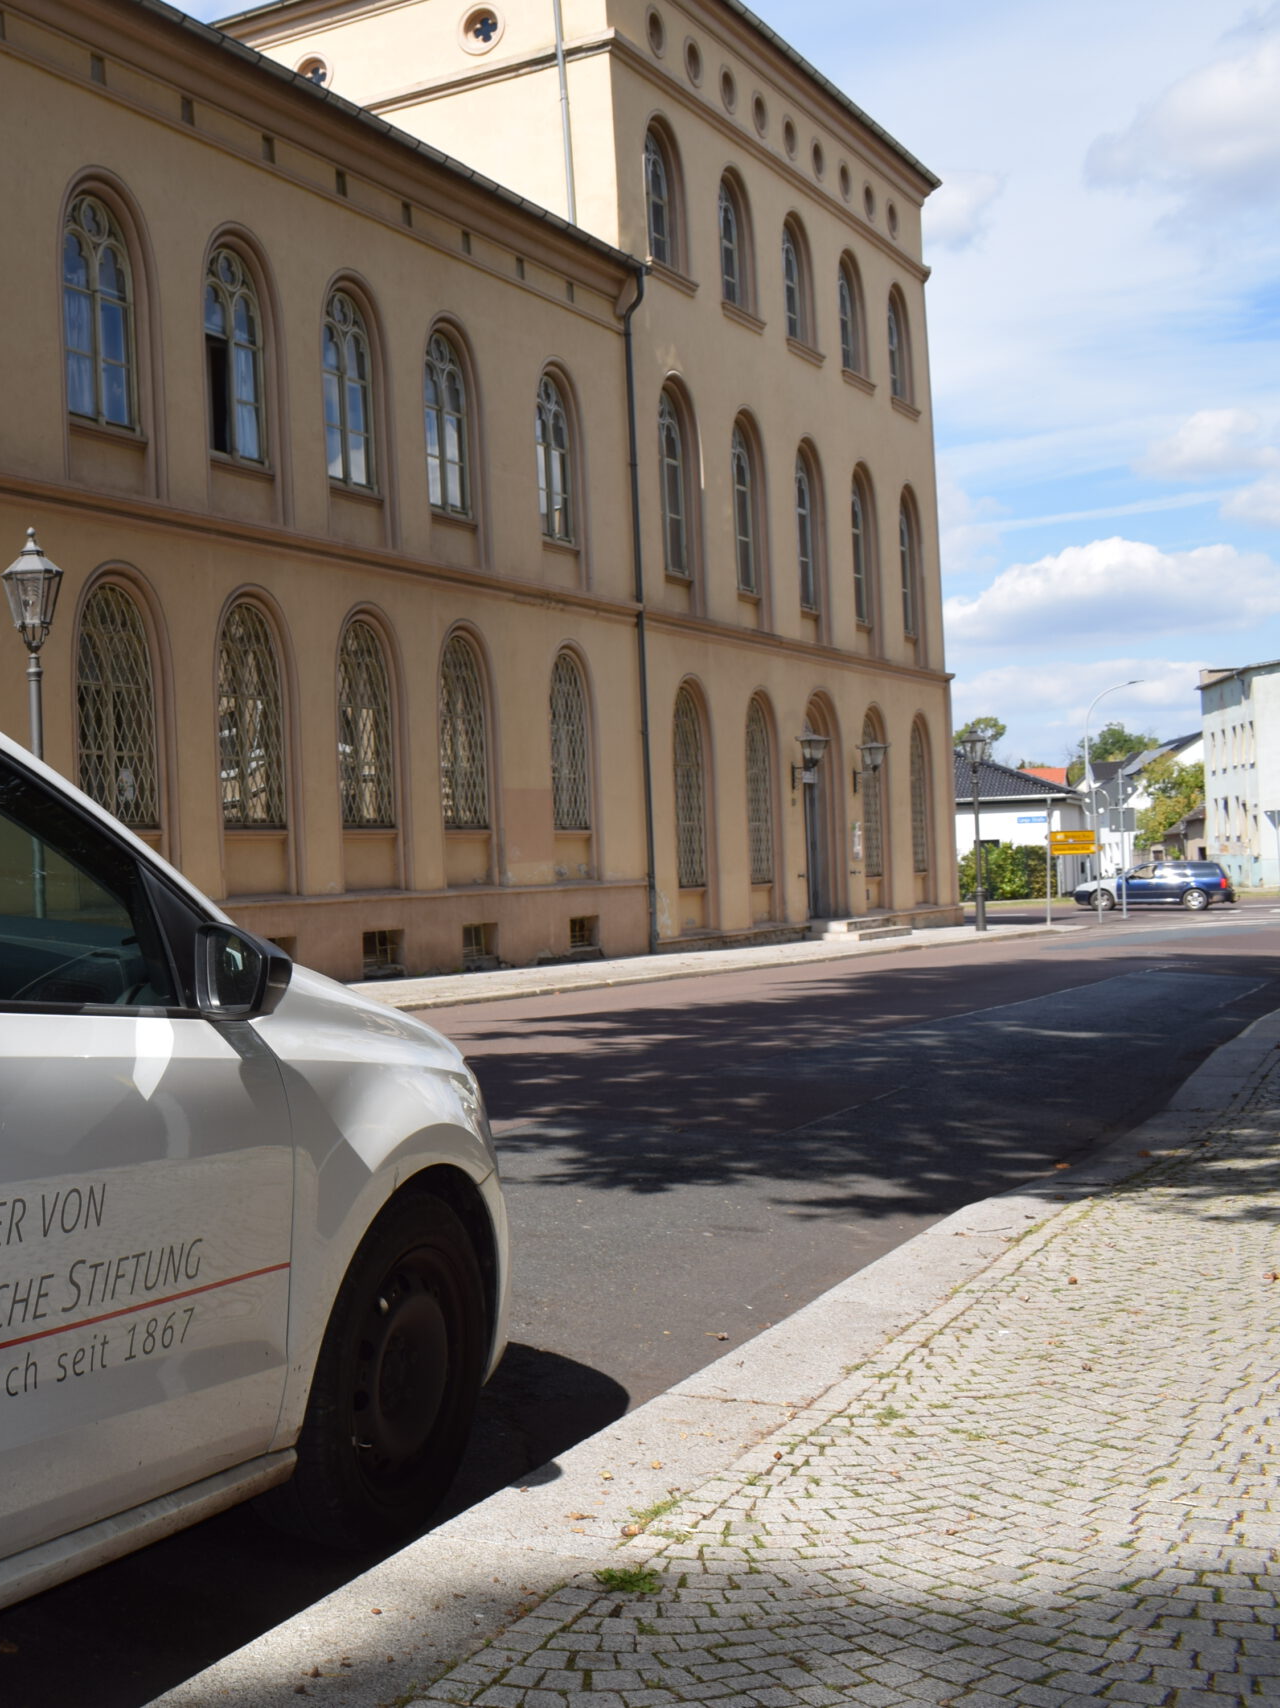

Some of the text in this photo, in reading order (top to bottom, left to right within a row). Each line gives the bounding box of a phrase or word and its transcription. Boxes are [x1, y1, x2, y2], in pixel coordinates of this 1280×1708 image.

[41, 1182, 107, 1239] VON
[61, 1237, 204, 1314] STIFTUNG
[56, 1334, 110, 1383] seit
[123, 1307, 196, 1362] 1867
